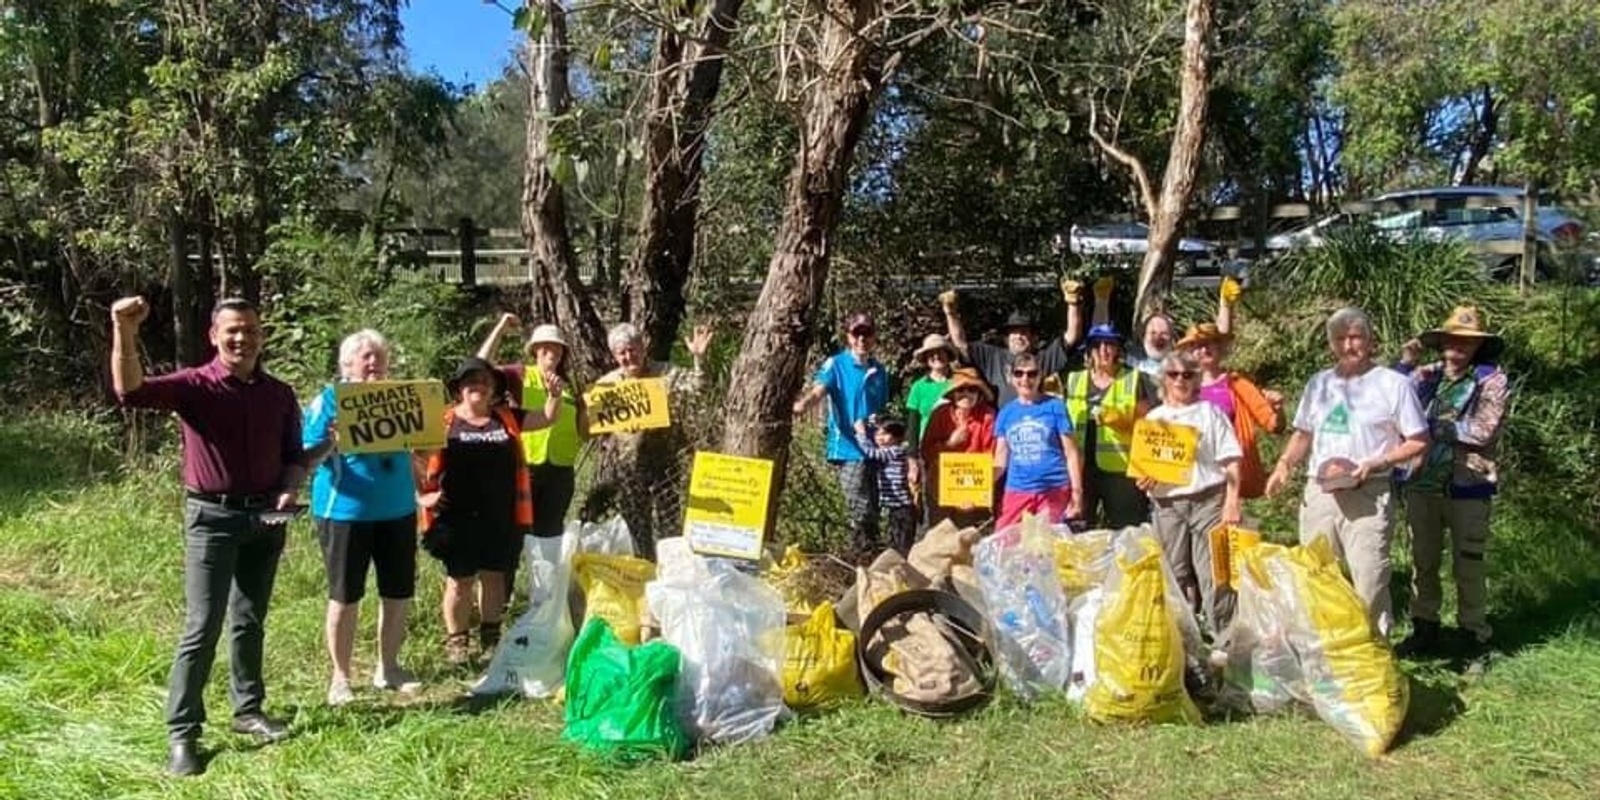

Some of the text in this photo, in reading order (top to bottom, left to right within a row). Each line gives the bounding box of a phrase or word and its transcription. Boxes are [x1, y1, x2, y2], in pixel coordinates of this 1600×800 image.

[340, 384, 417, 411] CLIMATE
[590, 383, 642, 402] CLIMATE
[602, 390, 649, 410] ACTION
[357, 396, 421, 422] ACTION
[597, 400, 652, 427] NOW
[348, 411, 424, 447] NOW
[1145, 436, 1185, 449] ACTION
